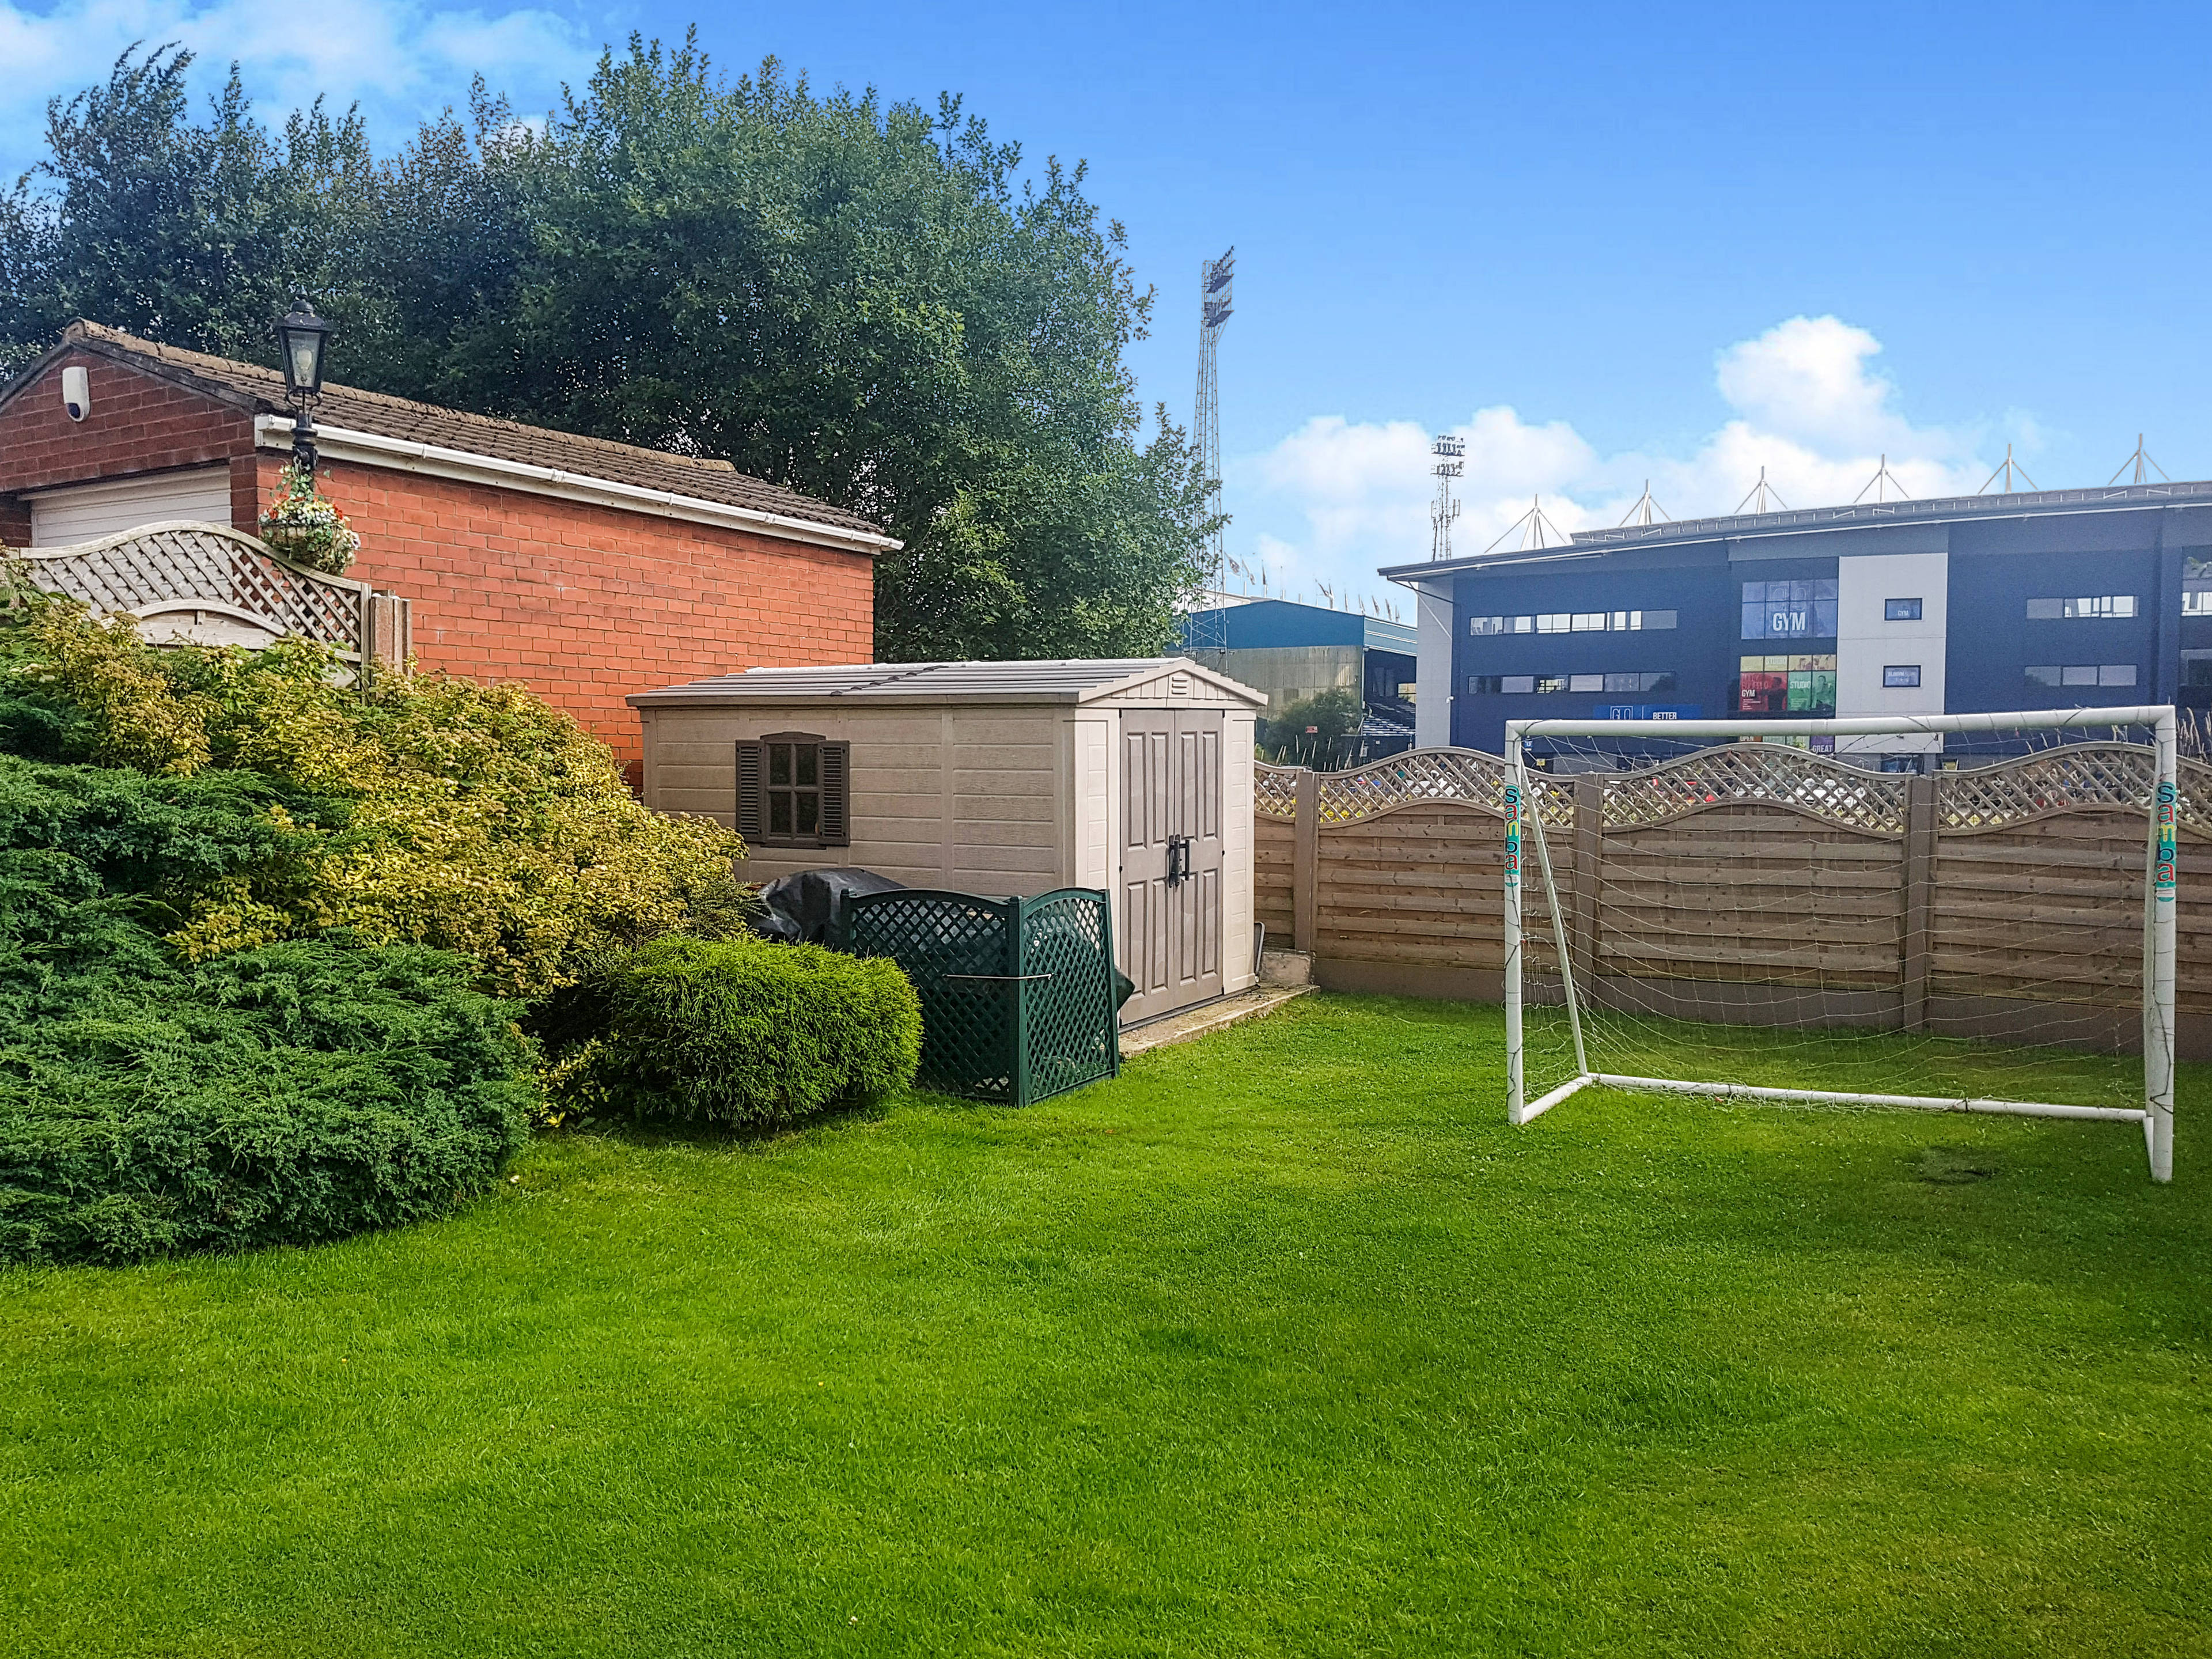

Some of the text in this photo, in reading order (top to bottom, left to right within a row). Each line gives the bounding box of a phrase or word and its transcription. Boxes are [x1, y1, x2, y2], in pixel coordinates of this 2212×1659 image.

[1772, 612, 1806, 631] GYM
[1790, 681, 1811, 689] STUDIO
[1812, 745, 1834, 753] GREAT
